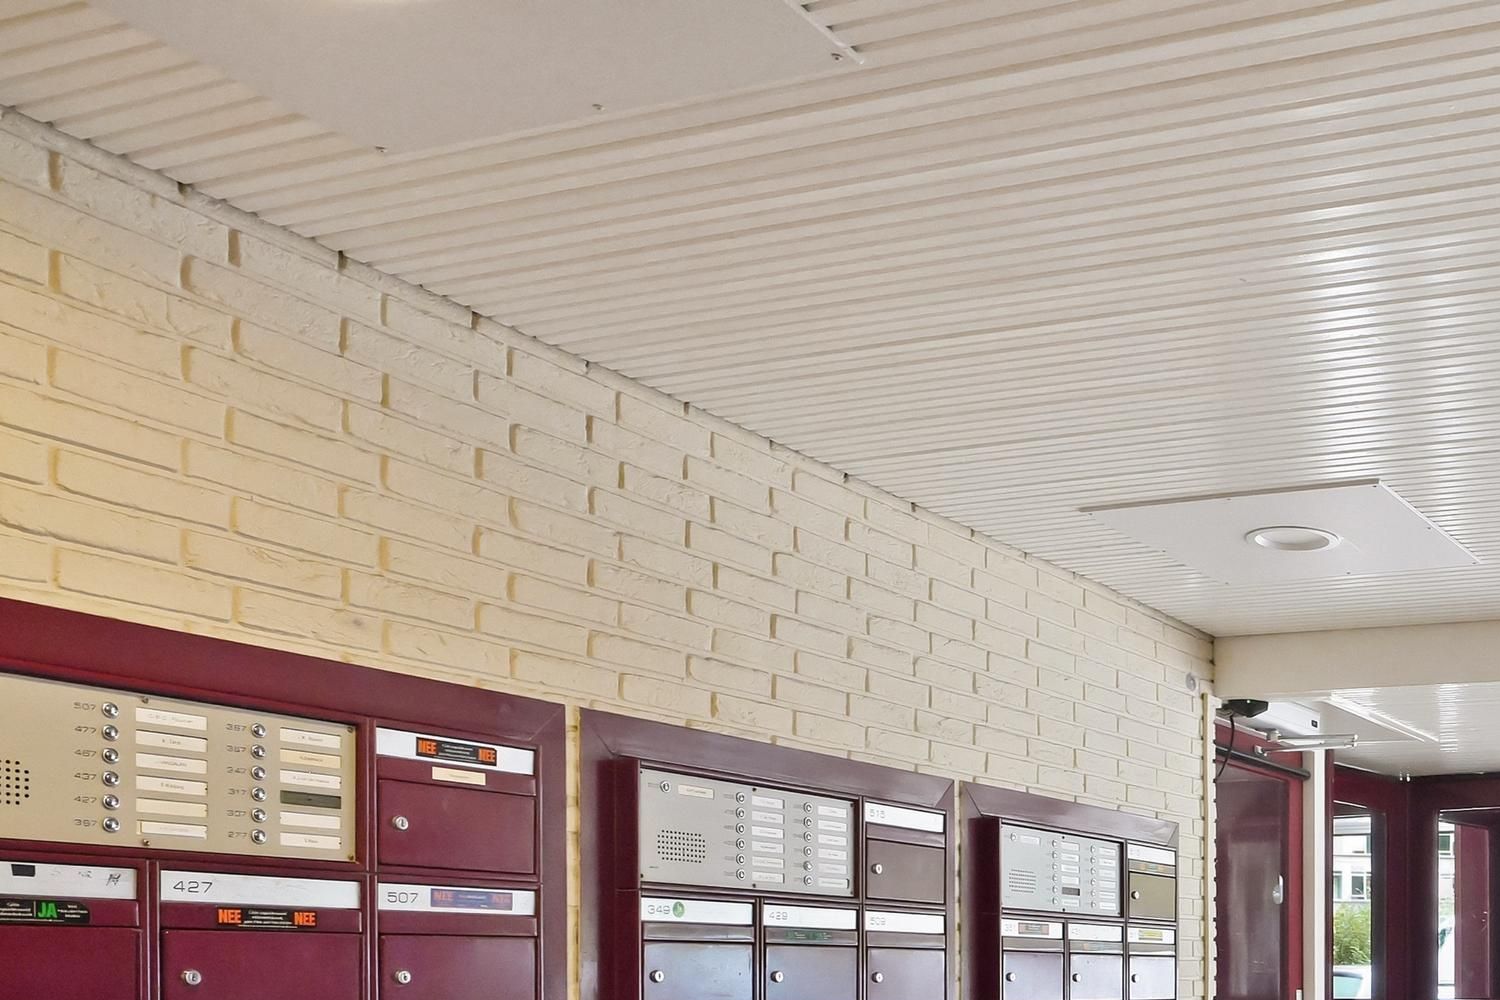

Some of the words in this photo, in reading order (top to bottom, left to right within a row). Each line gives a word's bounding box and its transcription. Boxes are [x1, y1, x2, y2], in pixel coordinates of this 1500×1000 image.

[418, 740, 438, 755] NEE
[173, 881, 213, 893] 427
[387, 891, 418, 904] 507
[38, 902, 58, 918] JA
[218, 909, 242, 924] NEE
[647, 904, 670, 915] 349
[294, 912, 316, 926] NEE
